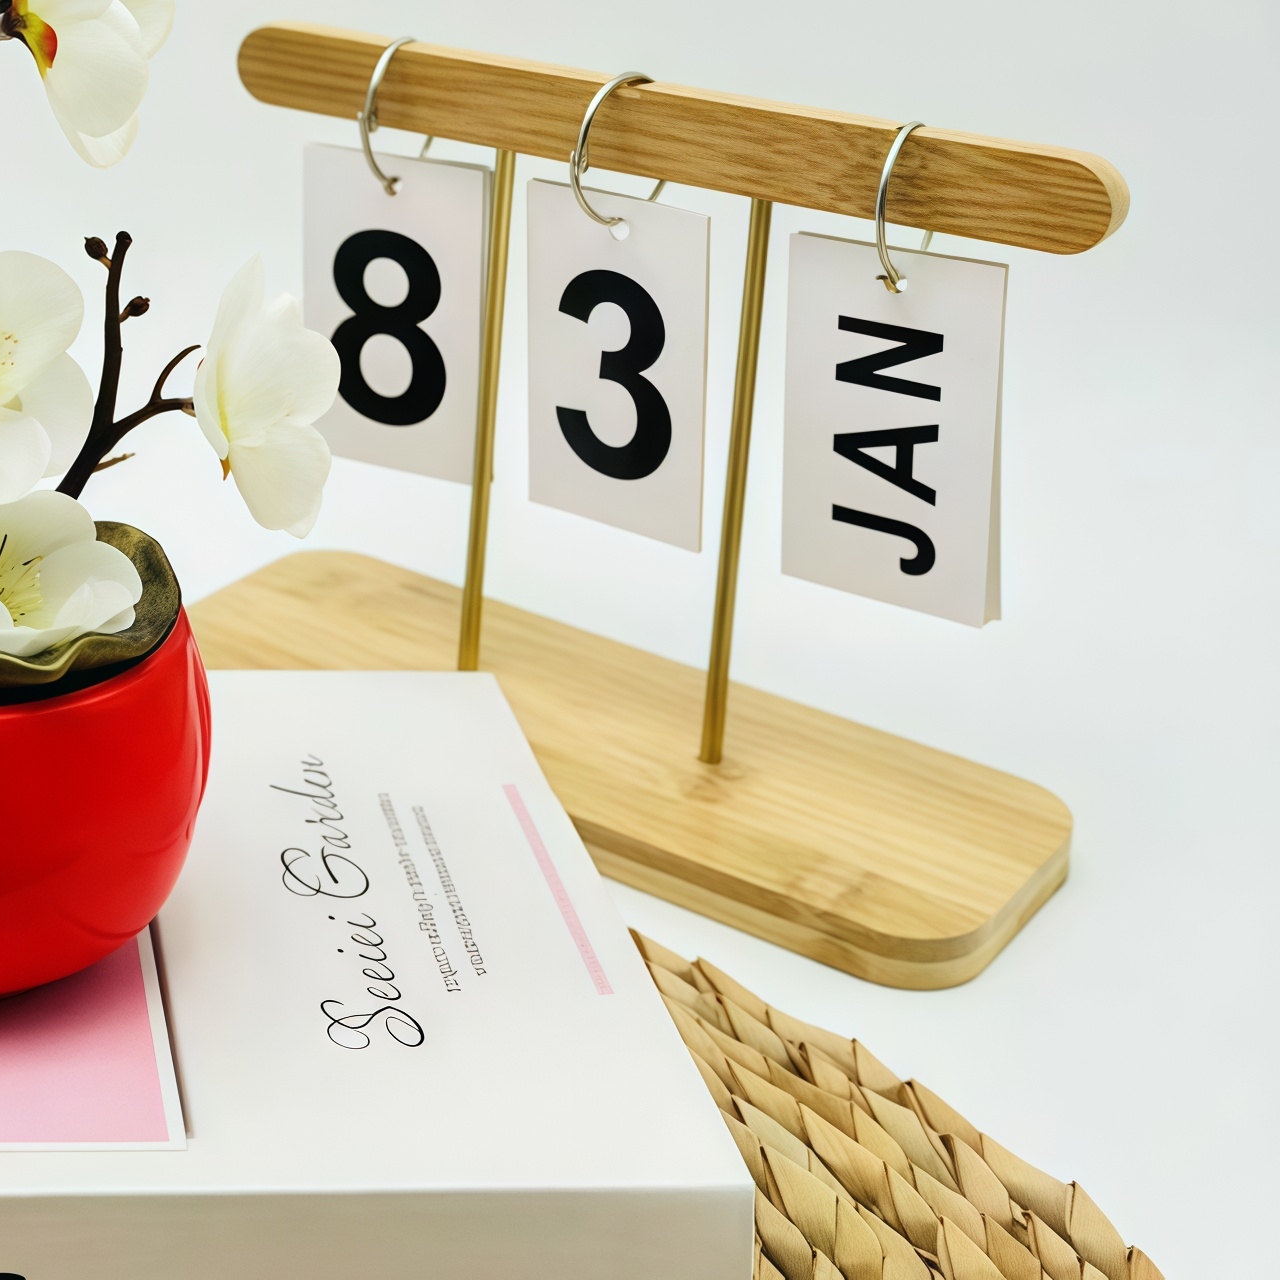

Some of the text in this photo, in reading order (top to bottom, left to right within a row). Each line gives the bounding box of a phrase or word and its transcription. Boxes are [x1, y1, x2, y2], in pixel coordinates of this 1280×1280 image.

[331, 229, 447, 427] 8
[555, 269, 672, 481] 3
[831, 314, 944, 577] JAN
